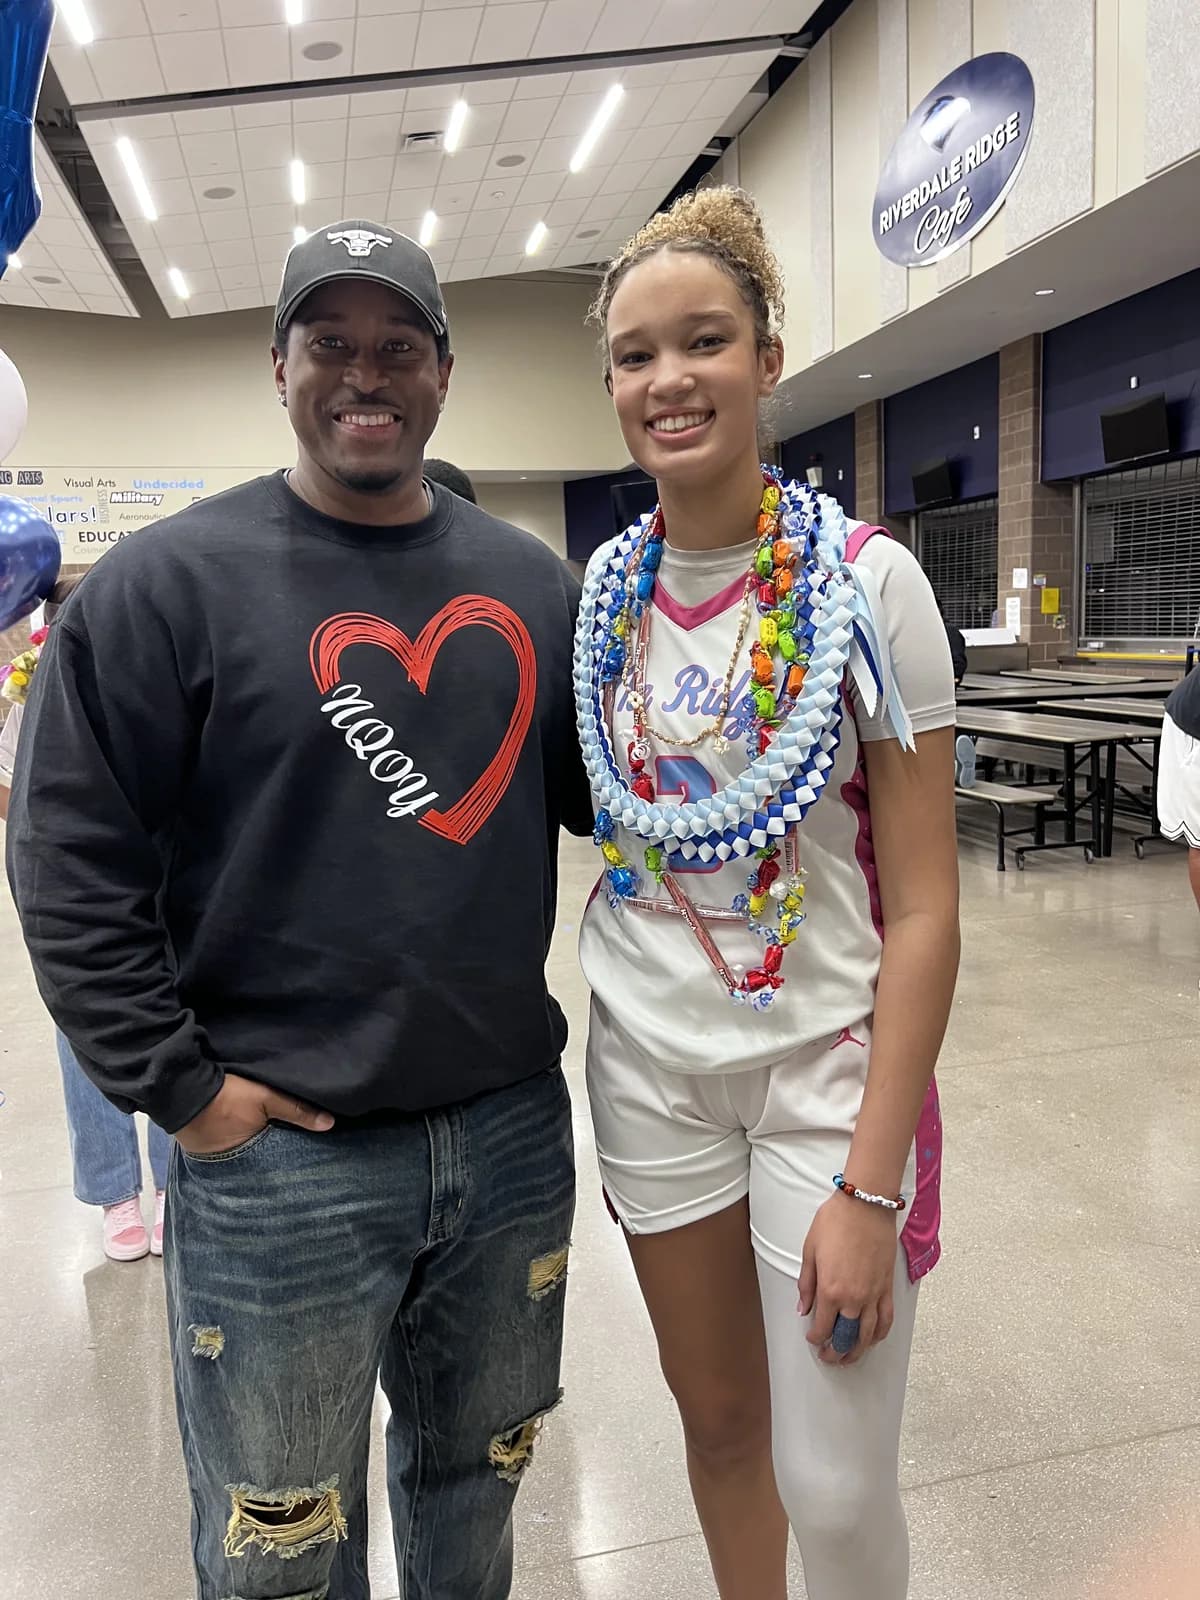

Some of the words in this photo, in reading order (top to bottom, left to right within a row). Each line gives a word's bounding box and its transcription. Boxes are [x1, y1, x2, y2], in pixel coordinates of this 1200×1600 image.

[879, 155, 963, 236] RIVERDALE
[964, 111, 1020, 175] RIDGE
[17, 470, 44, 485] ARTS
[63, 477, 94, 488] Visual
[96, 478, 117, 488] Arts
[132, 479, 204, 489] Undecided
[110, 491, 164, 506] Military
